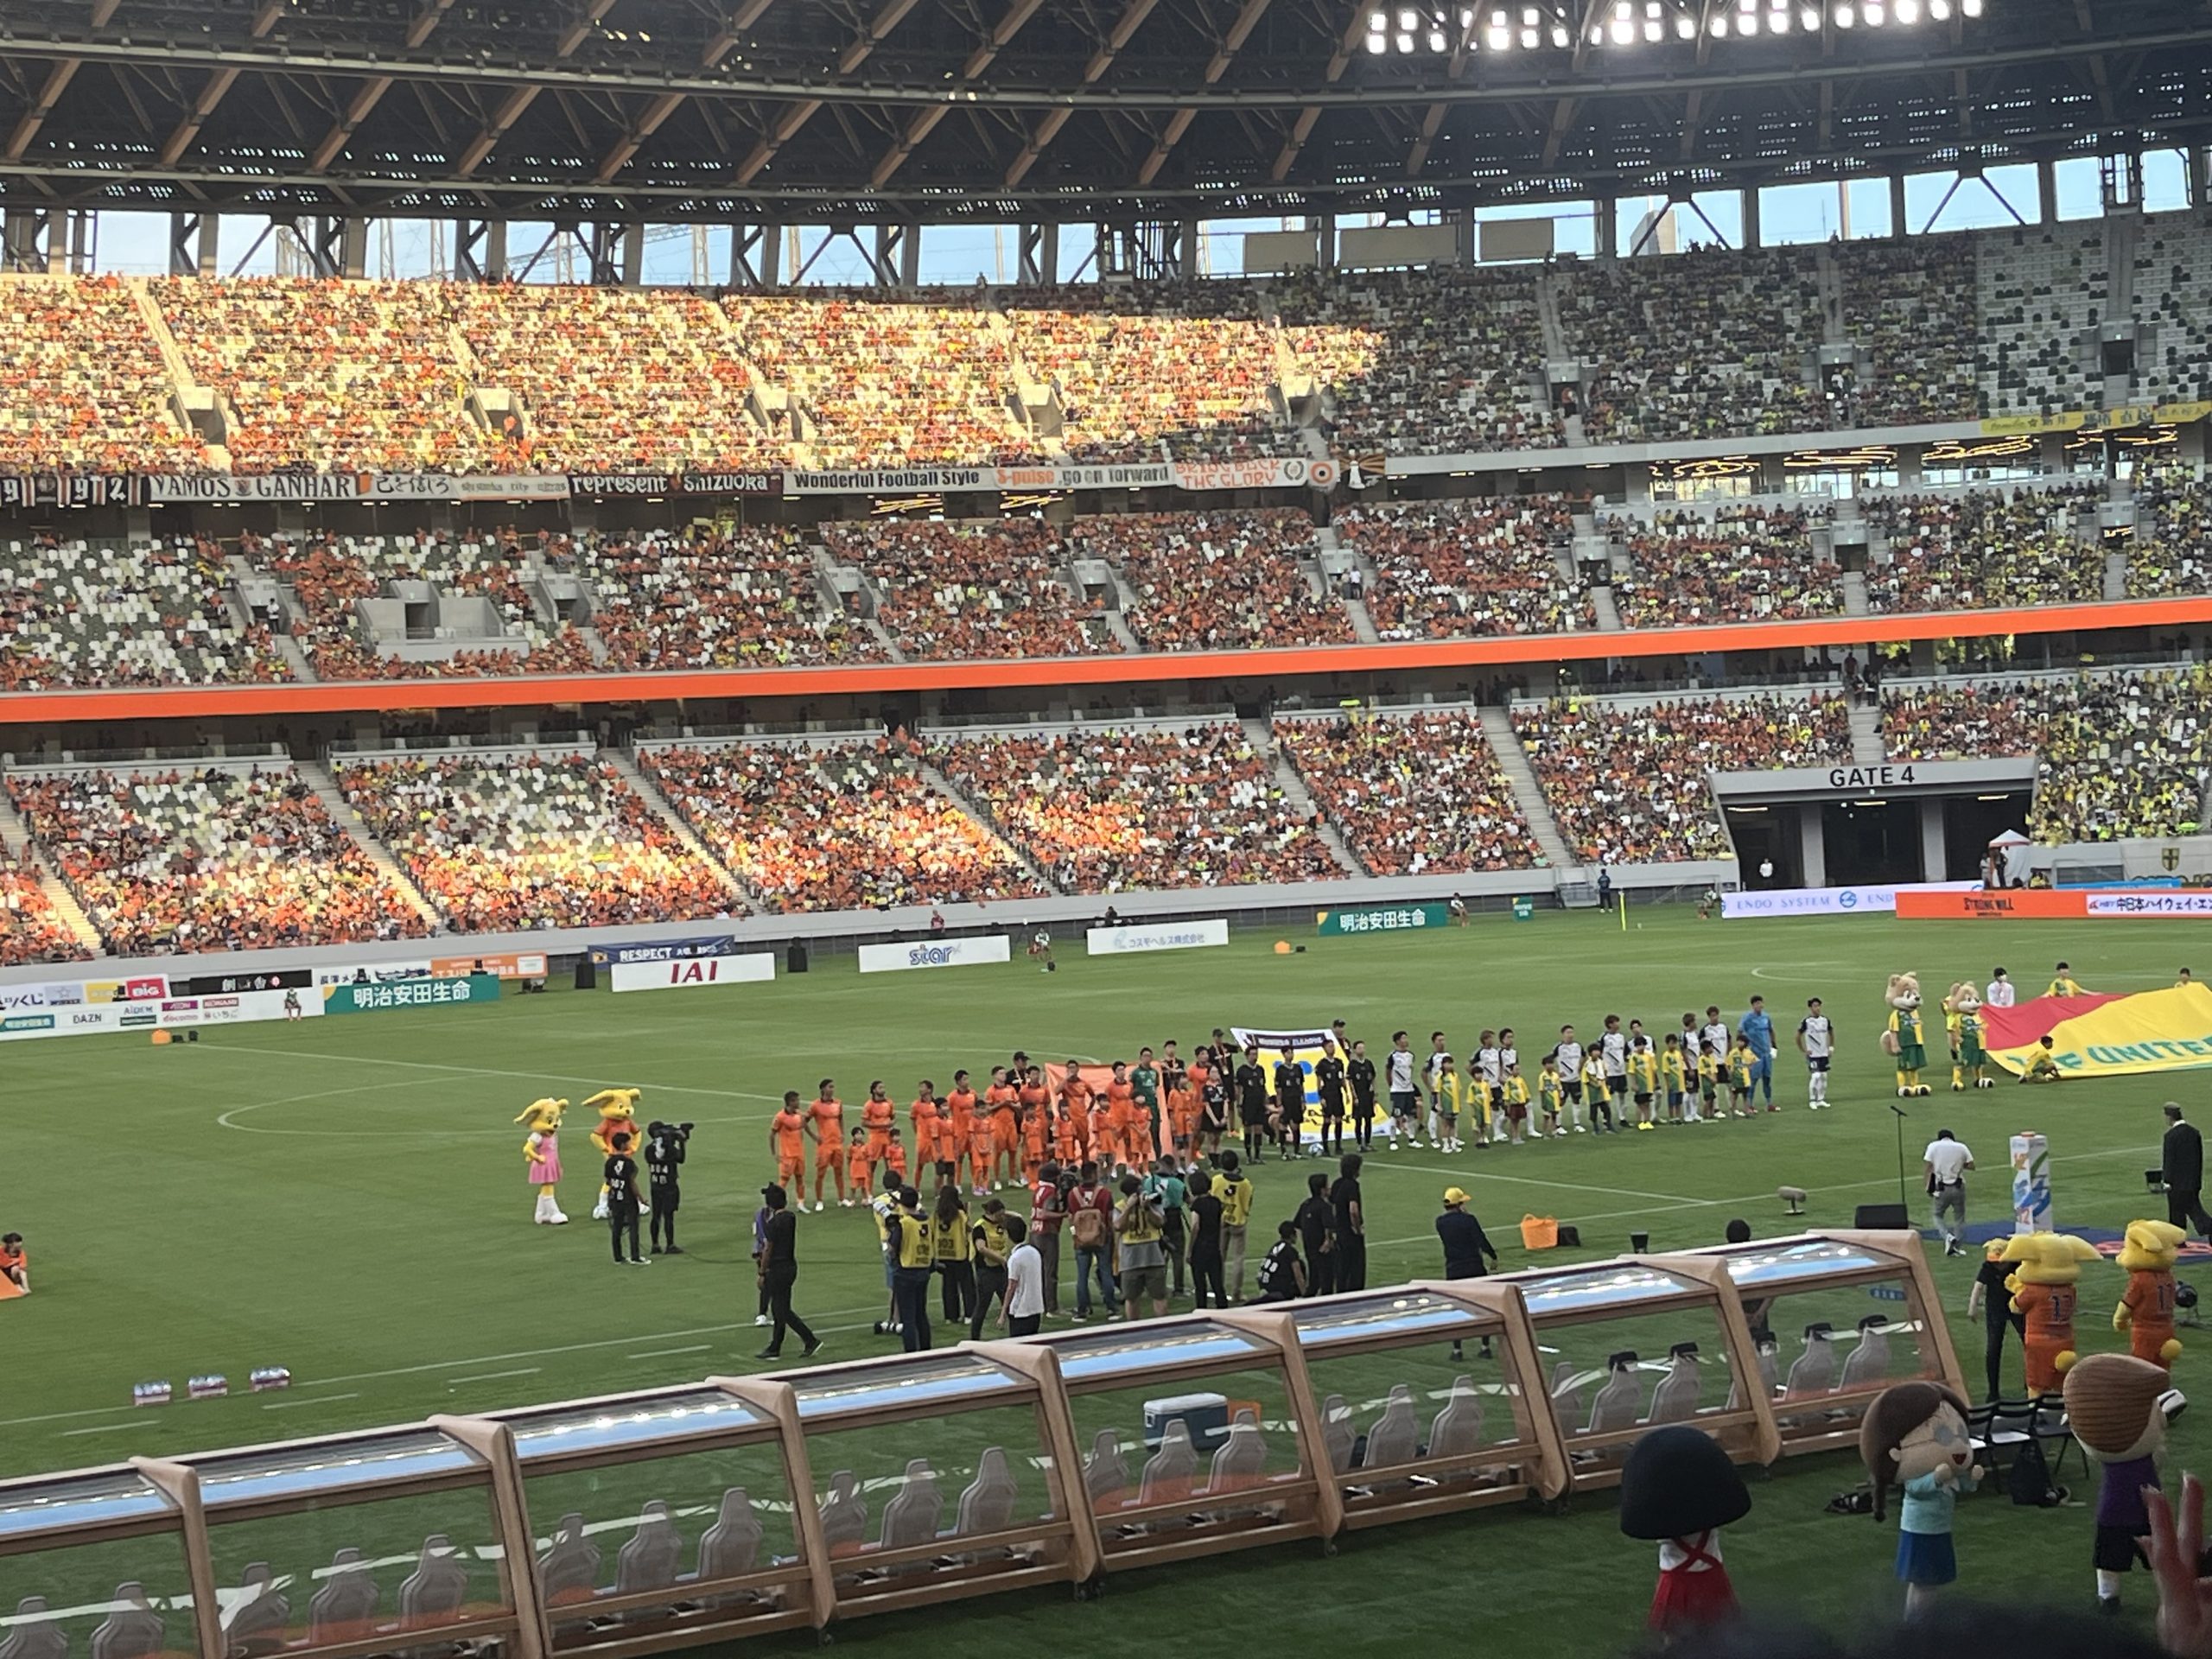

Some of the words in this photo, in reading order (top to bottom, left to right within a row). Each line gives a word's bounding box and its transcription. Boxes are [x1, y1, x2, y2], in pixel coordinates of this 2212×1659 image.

[153, 476, 232, 498] VAMOS
[257, 475, 351, 498] GANHAR
[794, 472, 874, 488] Wonderful
[878, 471, 938, 487] Football
[942, 468, 979, 486] Style
[997, 467, 1055, 486] S-pulse
[1109, 466, 1169, 482] forward
[1219, 473, 1276, 487] GLORY
[1829, 766, 1894, 787] GATE
[1901, 765, 1916, 784] 4
[1737, 899, 1772, 910] ENDO
[1780, 896, 1830, 907] SYSTEM
[1339, 907, 1426, 933] 明治安田生命
[620, 947, 672, 963] RESPECT
[909, 943, 953, 966] star
[671, 960, 718, 984] IAI
[353, 979, 472, 1009] 明治安田生命
[73, 1013, 102, 1024] DAZN
[2086, 1036, 2212, 1064] UNITE
